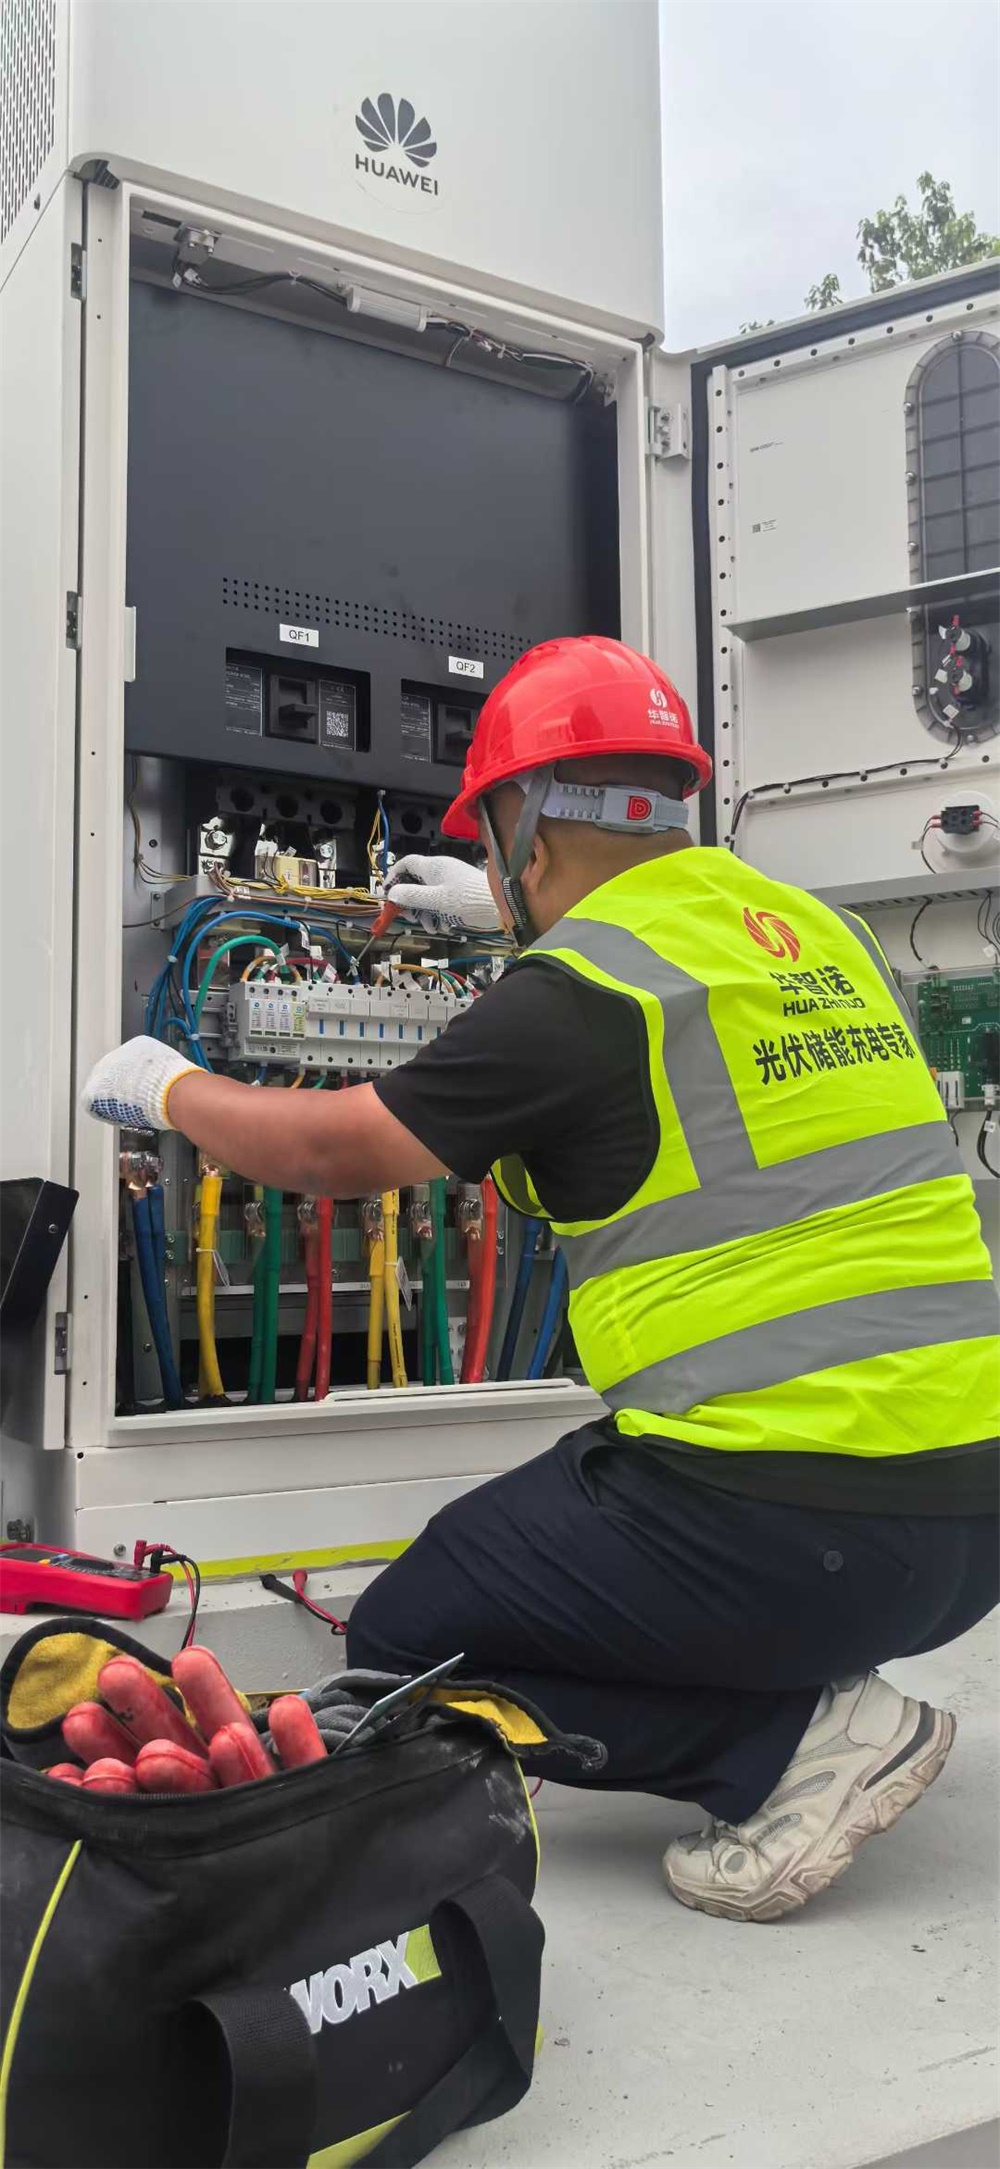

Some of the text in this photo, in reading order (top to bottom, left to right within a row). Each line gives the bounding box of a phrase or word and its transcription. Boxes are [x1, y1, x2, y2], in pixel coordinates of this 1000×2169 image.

[355, 153, 439, 195] HUAWEI
[289, 629, 310, 642] QF1
[456, 660, 476, 673] QF2
[769, 966, 855, 995] 华智诺
[783, 997, 820, 1017] HUA
[752, 1021, 916, 1085] 光伏储能充电专家
